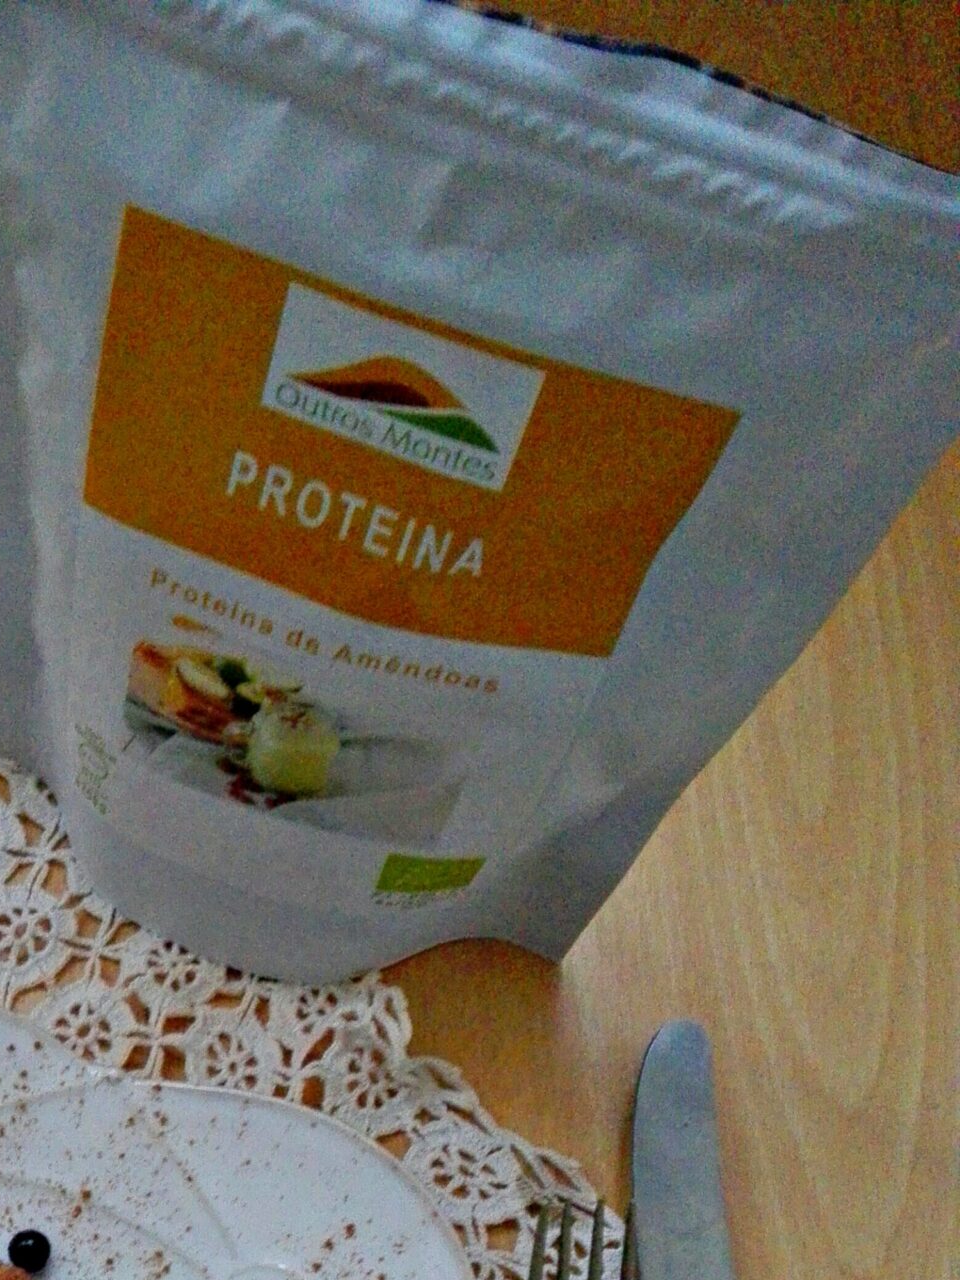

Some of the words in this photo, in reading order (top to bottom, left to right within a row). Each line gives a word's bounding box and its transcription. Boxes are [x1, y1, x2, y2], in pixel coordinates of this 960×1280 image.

[276, 383, 373, 438] Outros
[380, 423, 499, 481] Montes
[227, 450, 484, 578] PROTEINA
[285, 628, 321, 656] de
